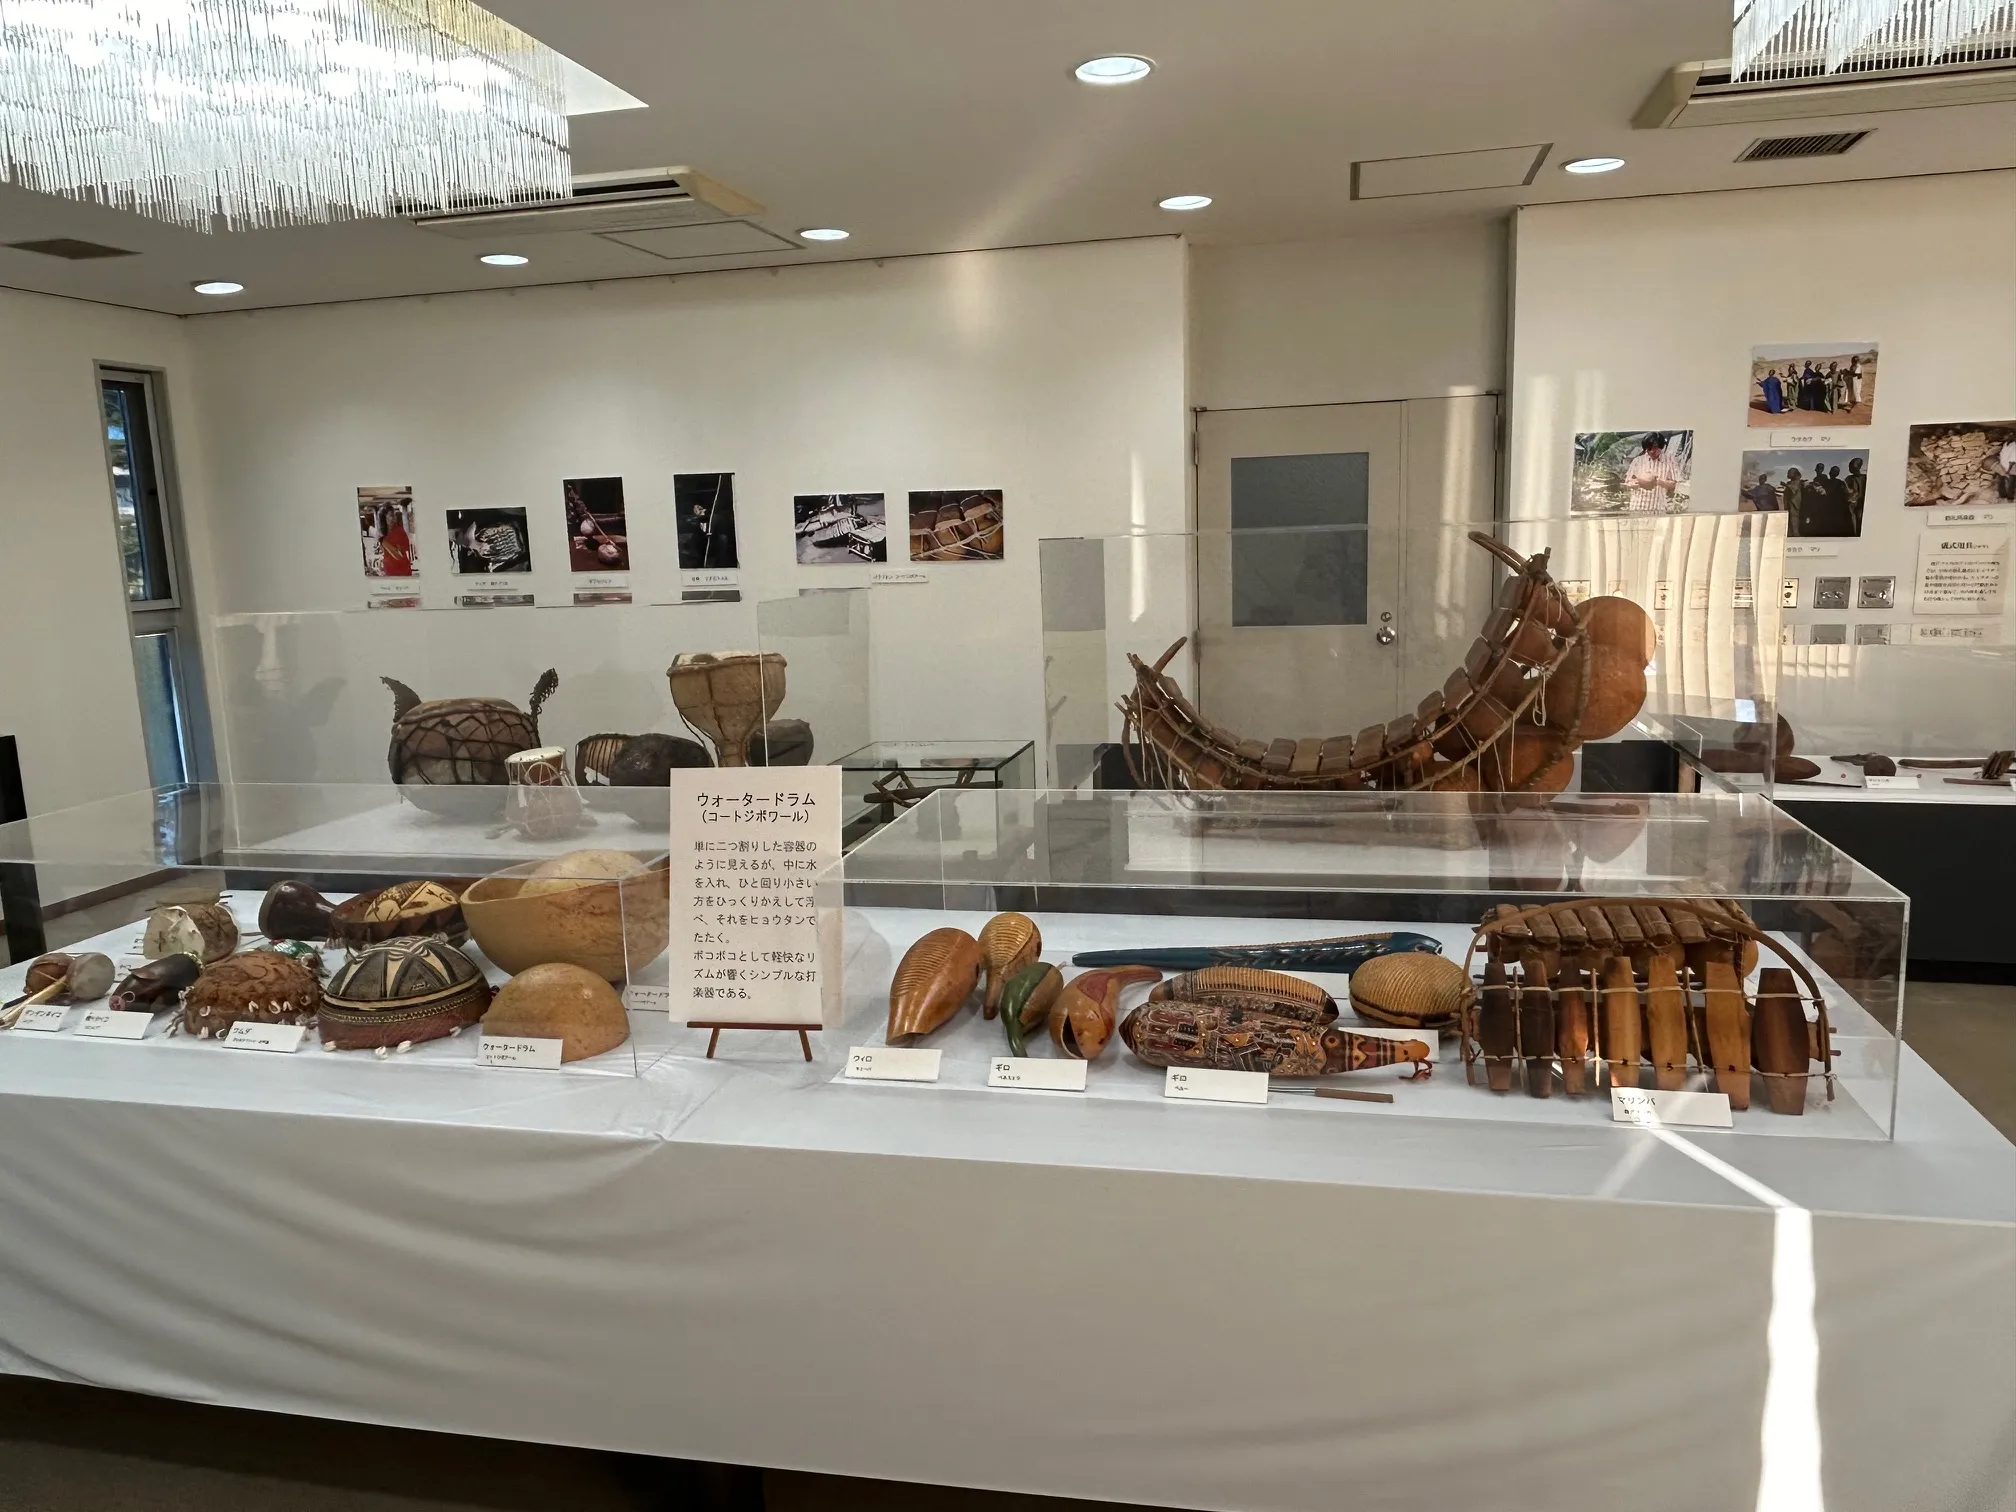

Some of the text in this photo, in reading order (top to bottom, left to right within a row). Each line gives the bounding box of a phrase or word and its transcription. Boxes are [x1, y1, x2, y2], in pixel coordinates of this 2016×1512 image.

[697, 793, 816, 807] ウォータードラム
[694, 840, 817, 852] 単に二つ割りした容器の
[694, 858, 817, 871] ように見えるが、中に水
[694, 877, 819, 889] を入れ、ひと回り小さい
[694, 932, 731, 944] たたく。
[693, 968, 817, 982] ズムが響くシンプルな打
[693, 986, 752, 1000] 楽器である。
[1617, 1096, 1656, 1106] マリンバ
